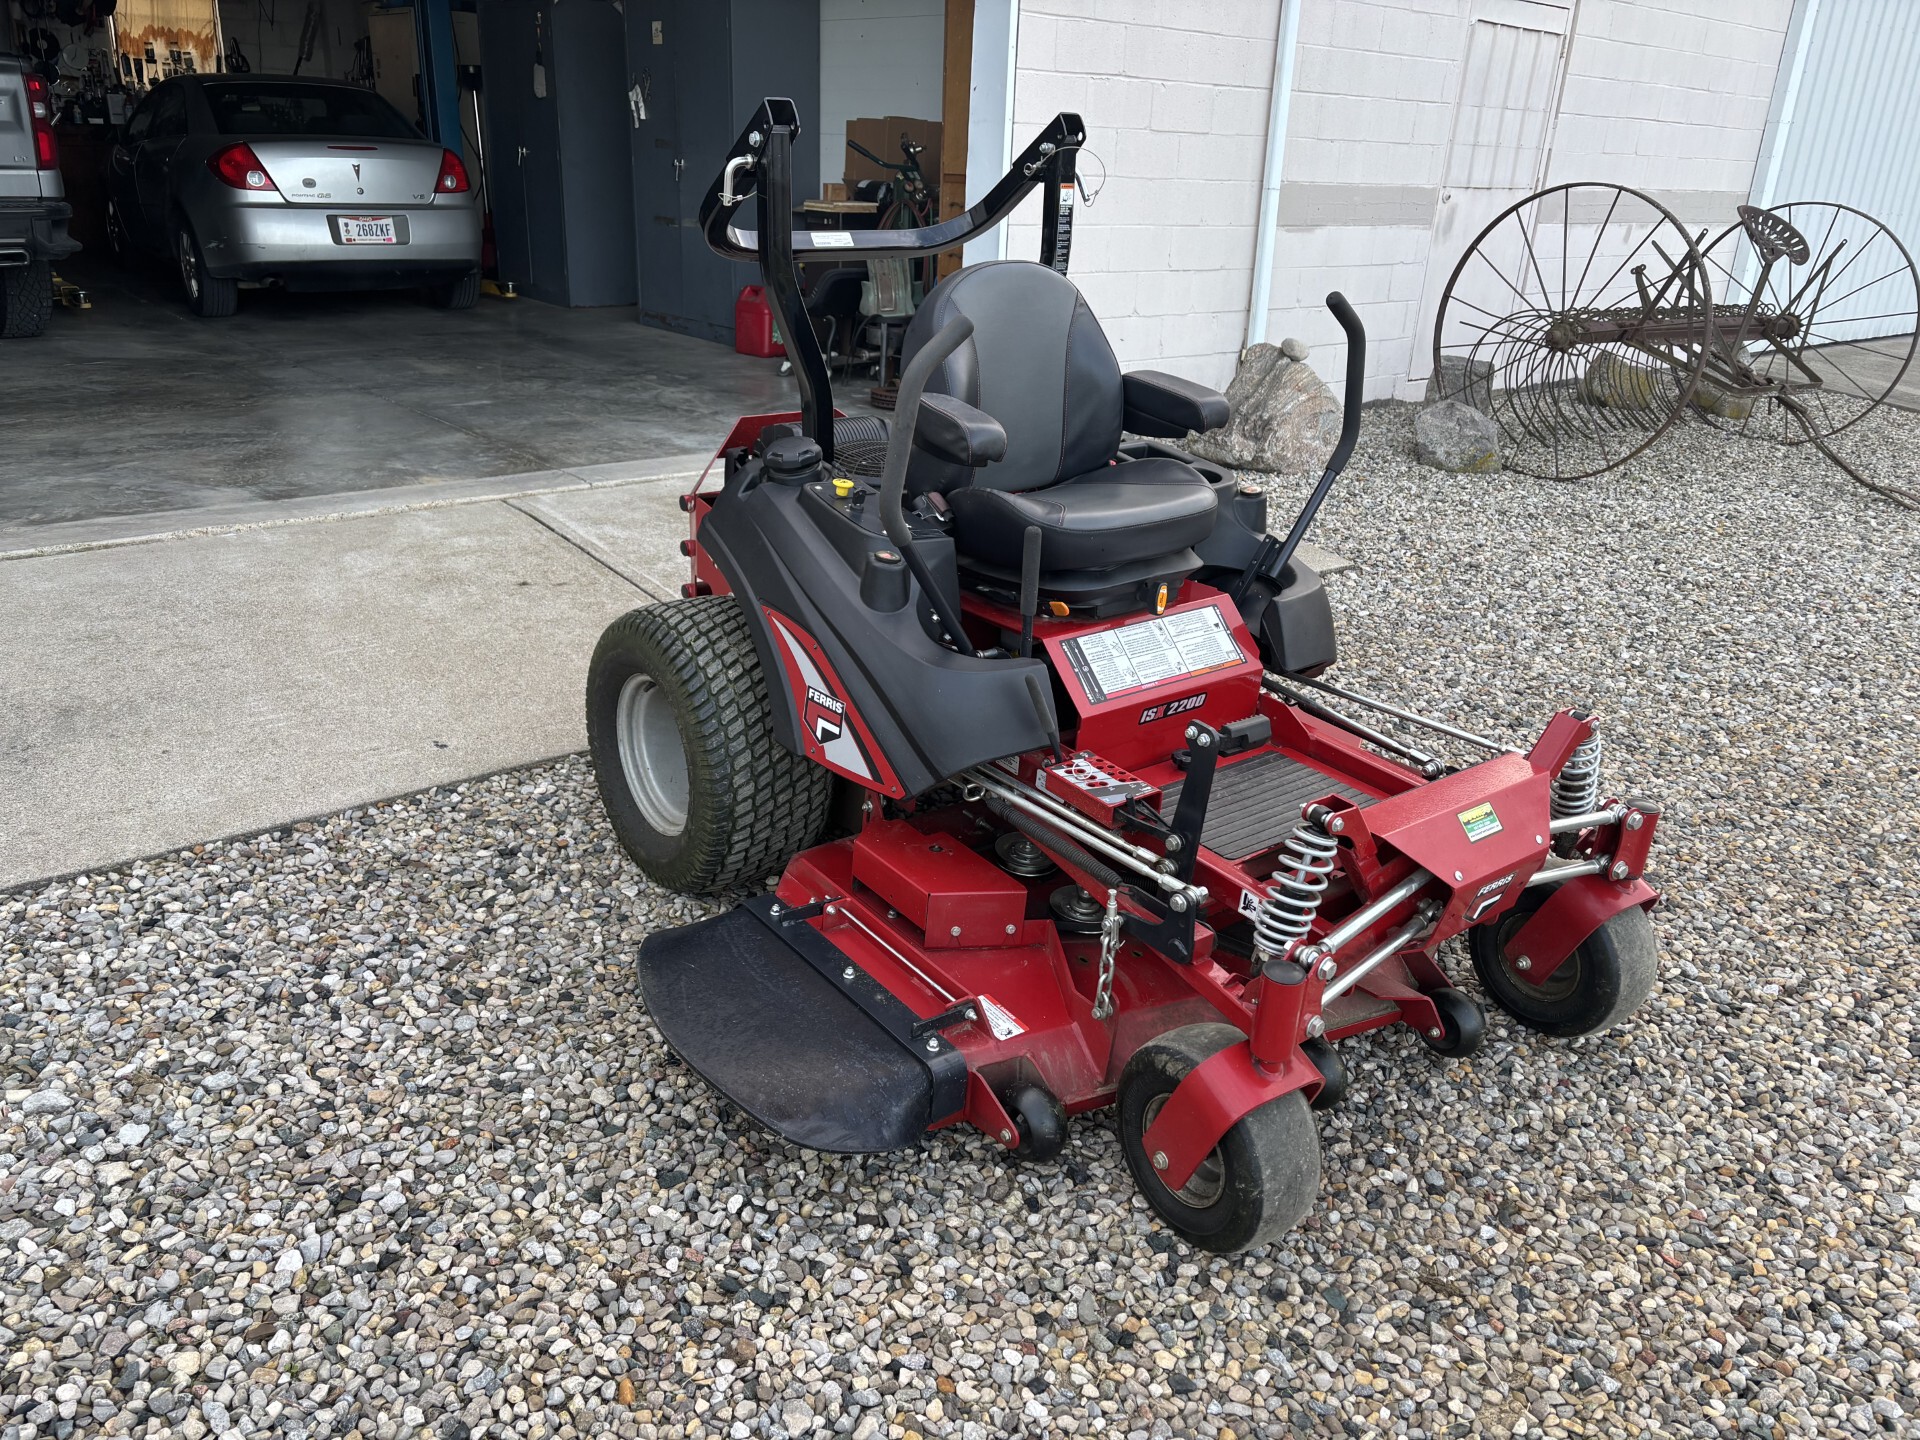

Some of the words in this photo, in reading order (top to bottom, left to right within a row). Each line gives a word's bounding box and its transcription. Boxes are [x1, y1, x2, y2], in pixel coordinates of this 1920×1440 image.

[355, 223, 391, 237] 268ZKF
[808, 689, 844, 714] FERRIS
[1140, 705, 1165, 724] ISX
[1166, 693, 1206, 716] 2200
[1477, 873, 1514, 897] FERRIS
